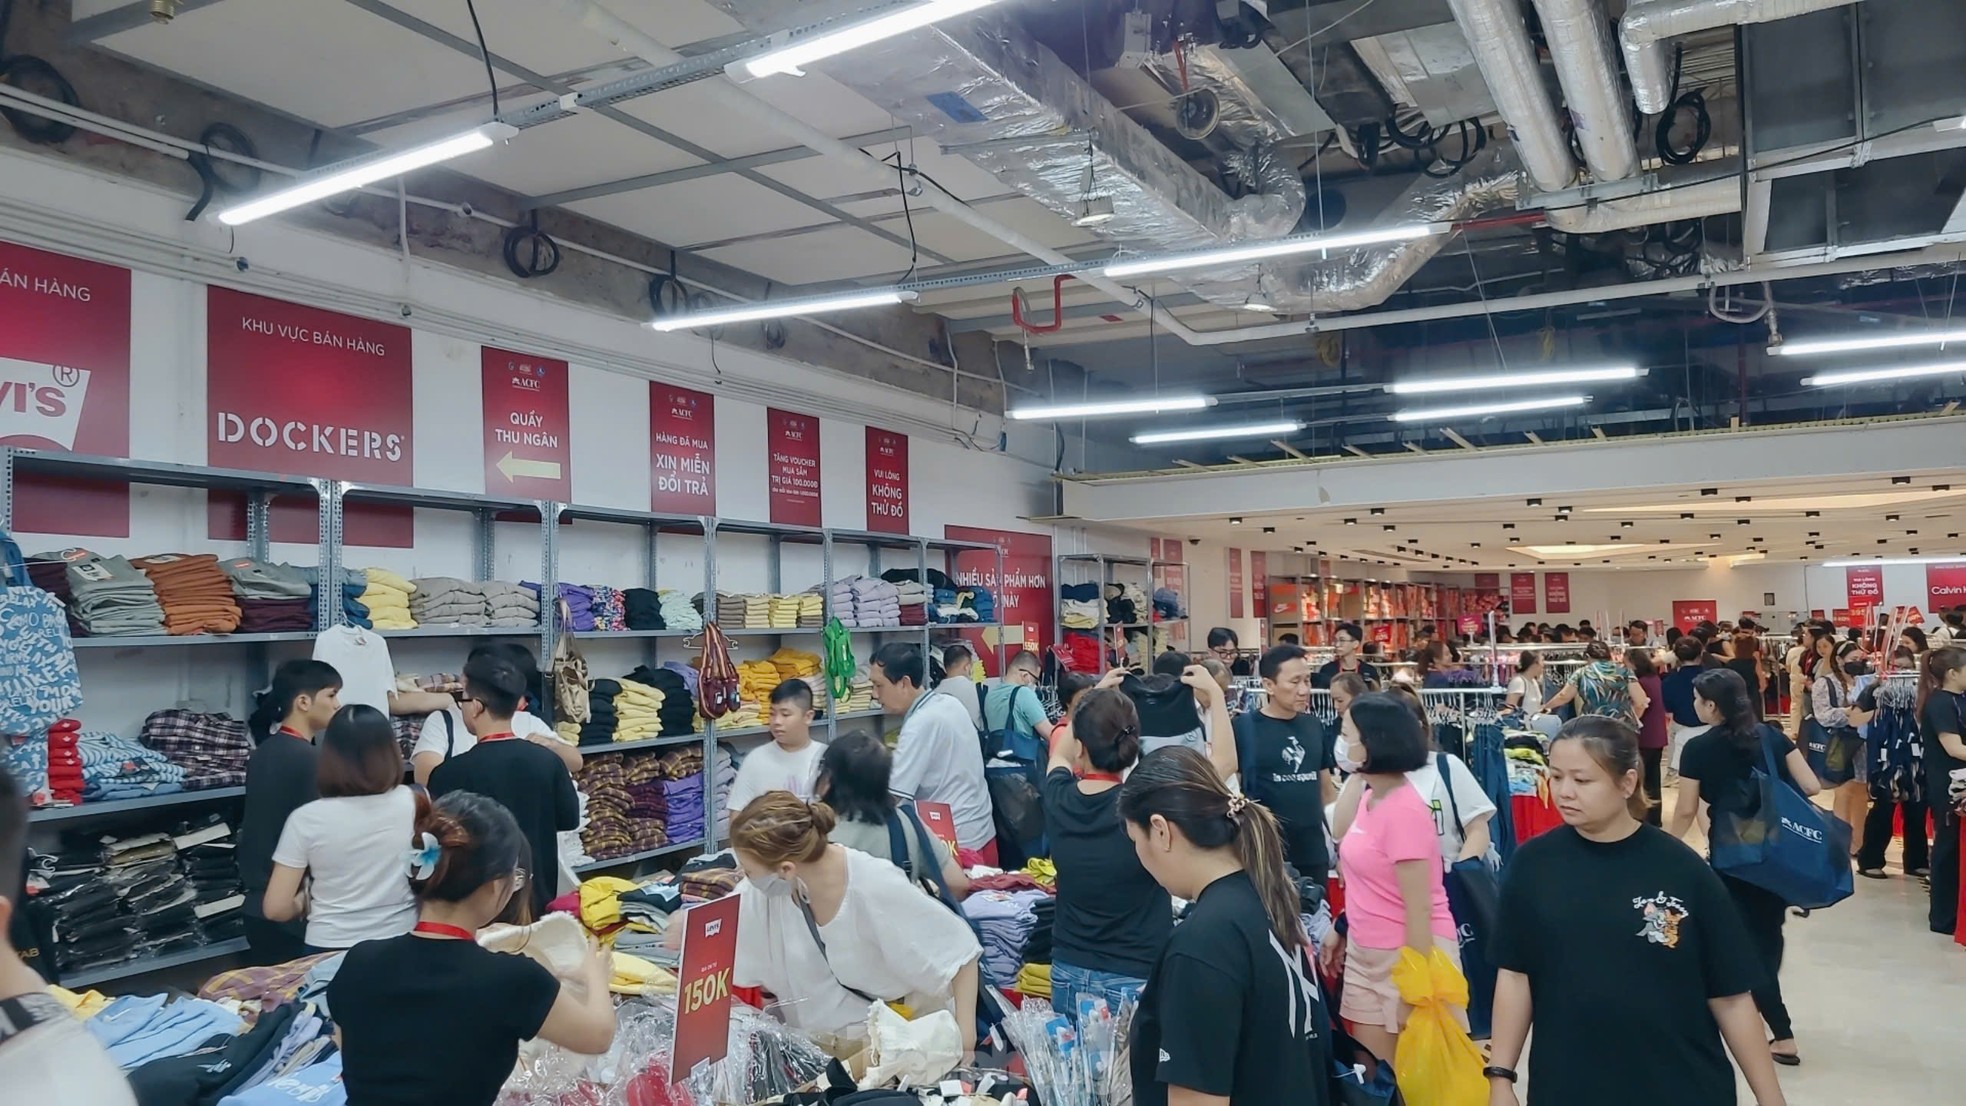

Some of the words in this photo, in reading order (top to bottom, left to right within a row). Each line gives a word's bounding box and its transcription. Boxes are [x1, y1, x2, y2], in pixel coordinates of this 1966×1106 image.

[35, 276, 91, 302] HÀNG
[242, 317, 274, 335] KHU
[278, 324, 309, 342] VỰC
[313, 331, 343, 348] BÁN
[347, 336, 385, 356] HÀNG
[217, 412, 402, 461] DOCKERS
[495, 429, 520, 444] THU
[524, 431, 558, 448] NGÂN
[656, 431, 678, 445] HÀNG
[680, 436, 690, 447] ĐÃ
[692, 439, 708, 450] MUA
[656, 453, 677, 470] XIN
[681, 453, 710, 475] MIỄN
[782, 466, 795, 475] MUA
[790, 456, 816, 468] VOUCHER
[873, 469, 884, 478] VUI
[659, 471, 681, 493] ĐỔI
[685, 476, 709, 496] TRẢ
[872, 482, 902, 500] KHÔNG
[871, 499, 890, 516] THỬ
[1004, 567, 1027, 588] PHẨM
[1028, 574, 1046, 588] HƠN
[1931, 585, 1962, 595] Calvin
[1792, 822, 1823, 841] ACFC
[684, 967, 730, 1015] 150K
